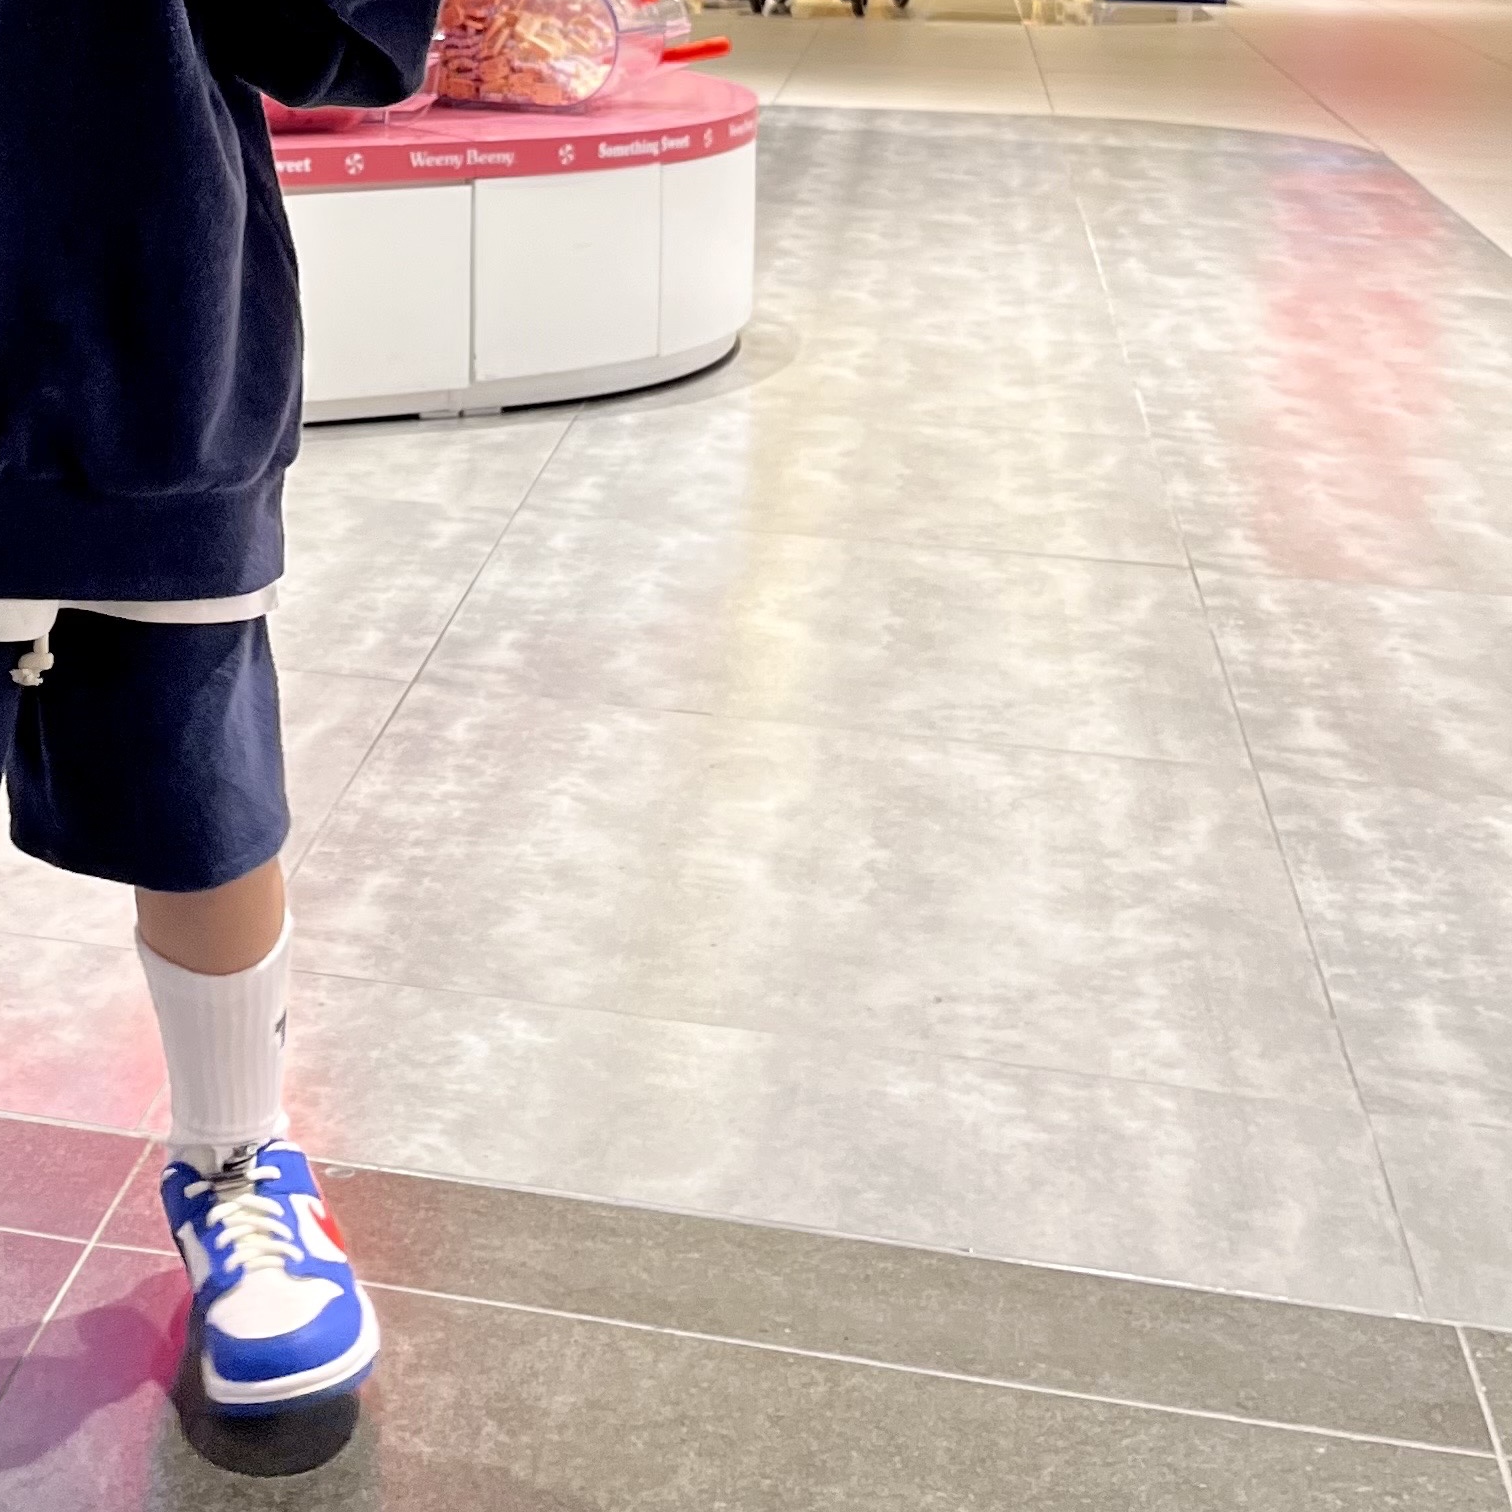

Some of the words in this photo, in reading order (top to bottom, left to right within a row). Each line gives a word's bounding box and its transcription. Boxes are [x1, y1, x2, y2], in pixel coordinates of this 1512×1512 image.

[409, 149, 464, 170] Weeny
[598, 140, 660, 160] Something
[276, 155, 312, 174] weet
